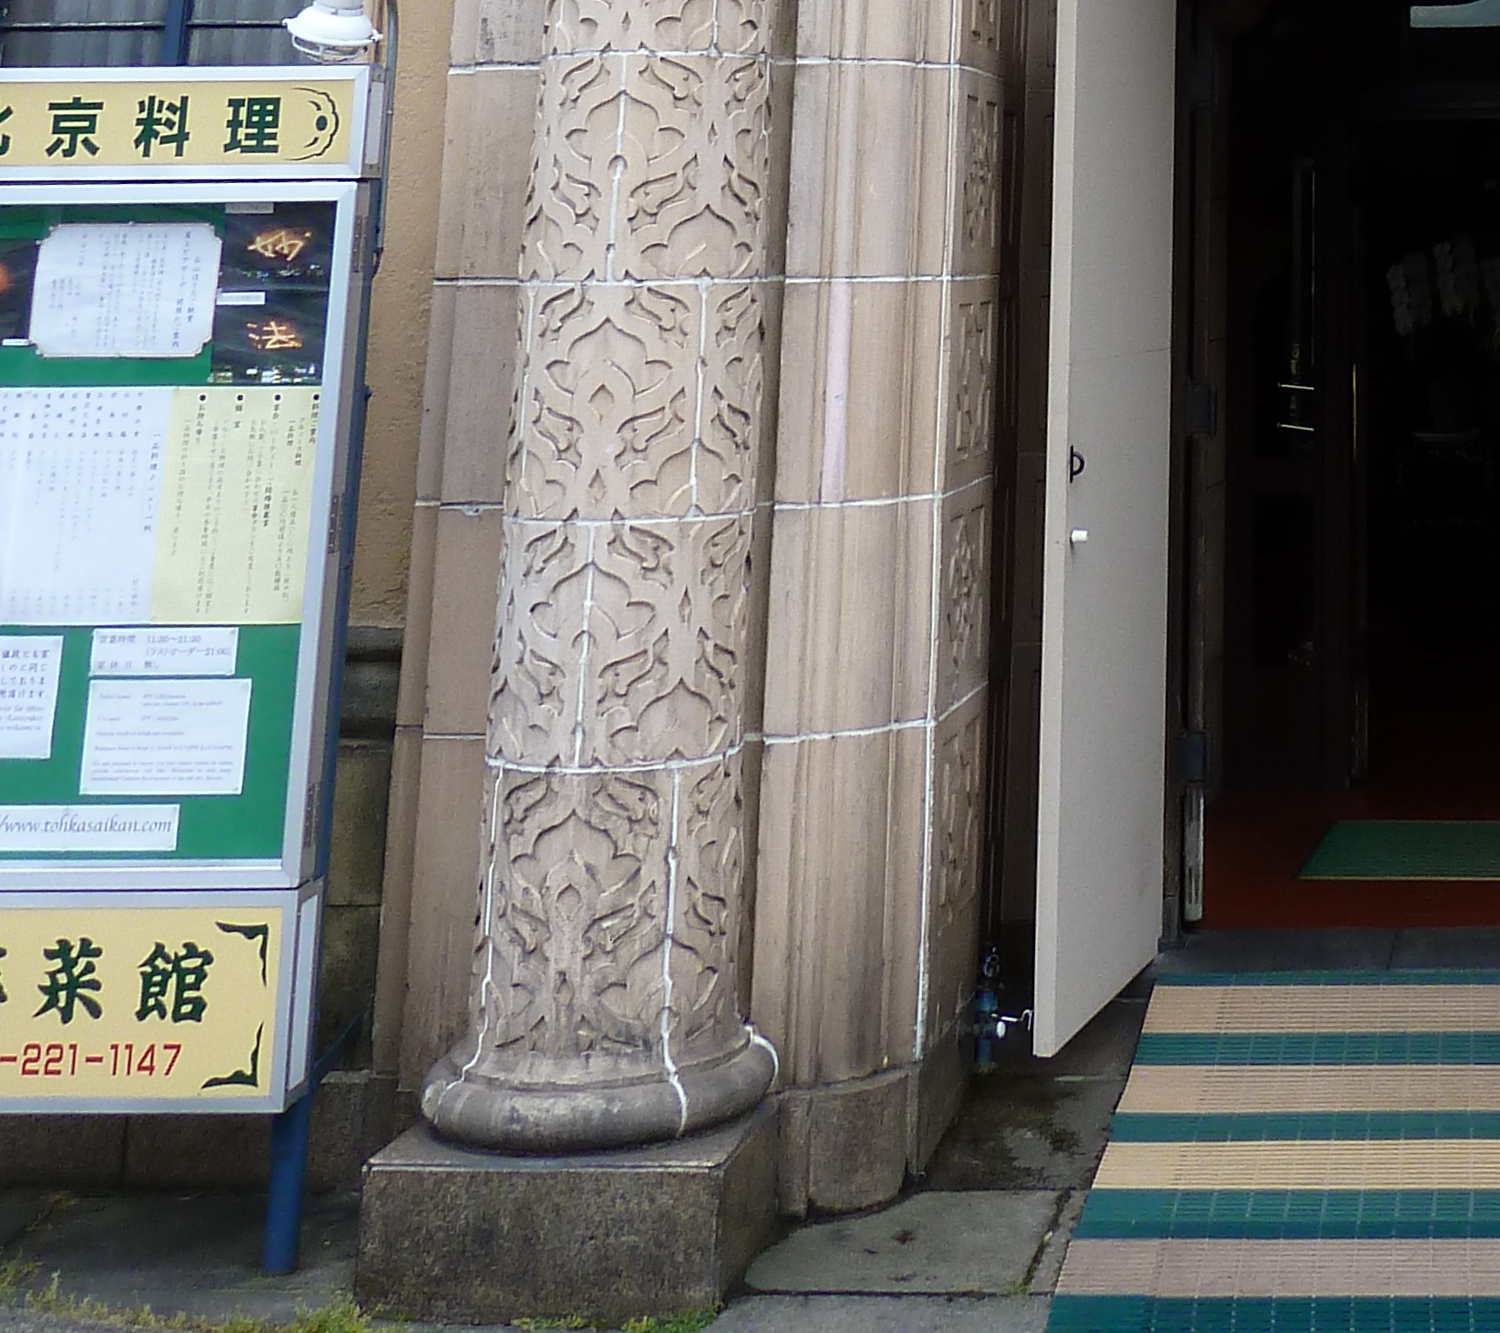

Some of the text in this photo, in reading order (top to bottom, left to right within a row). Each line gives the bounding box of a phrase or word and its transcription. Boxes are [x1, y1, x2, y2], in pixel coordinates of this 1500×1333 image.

[0, 95, 281, 157] 京料理
[0, 937, 213, 1024] 菜館
